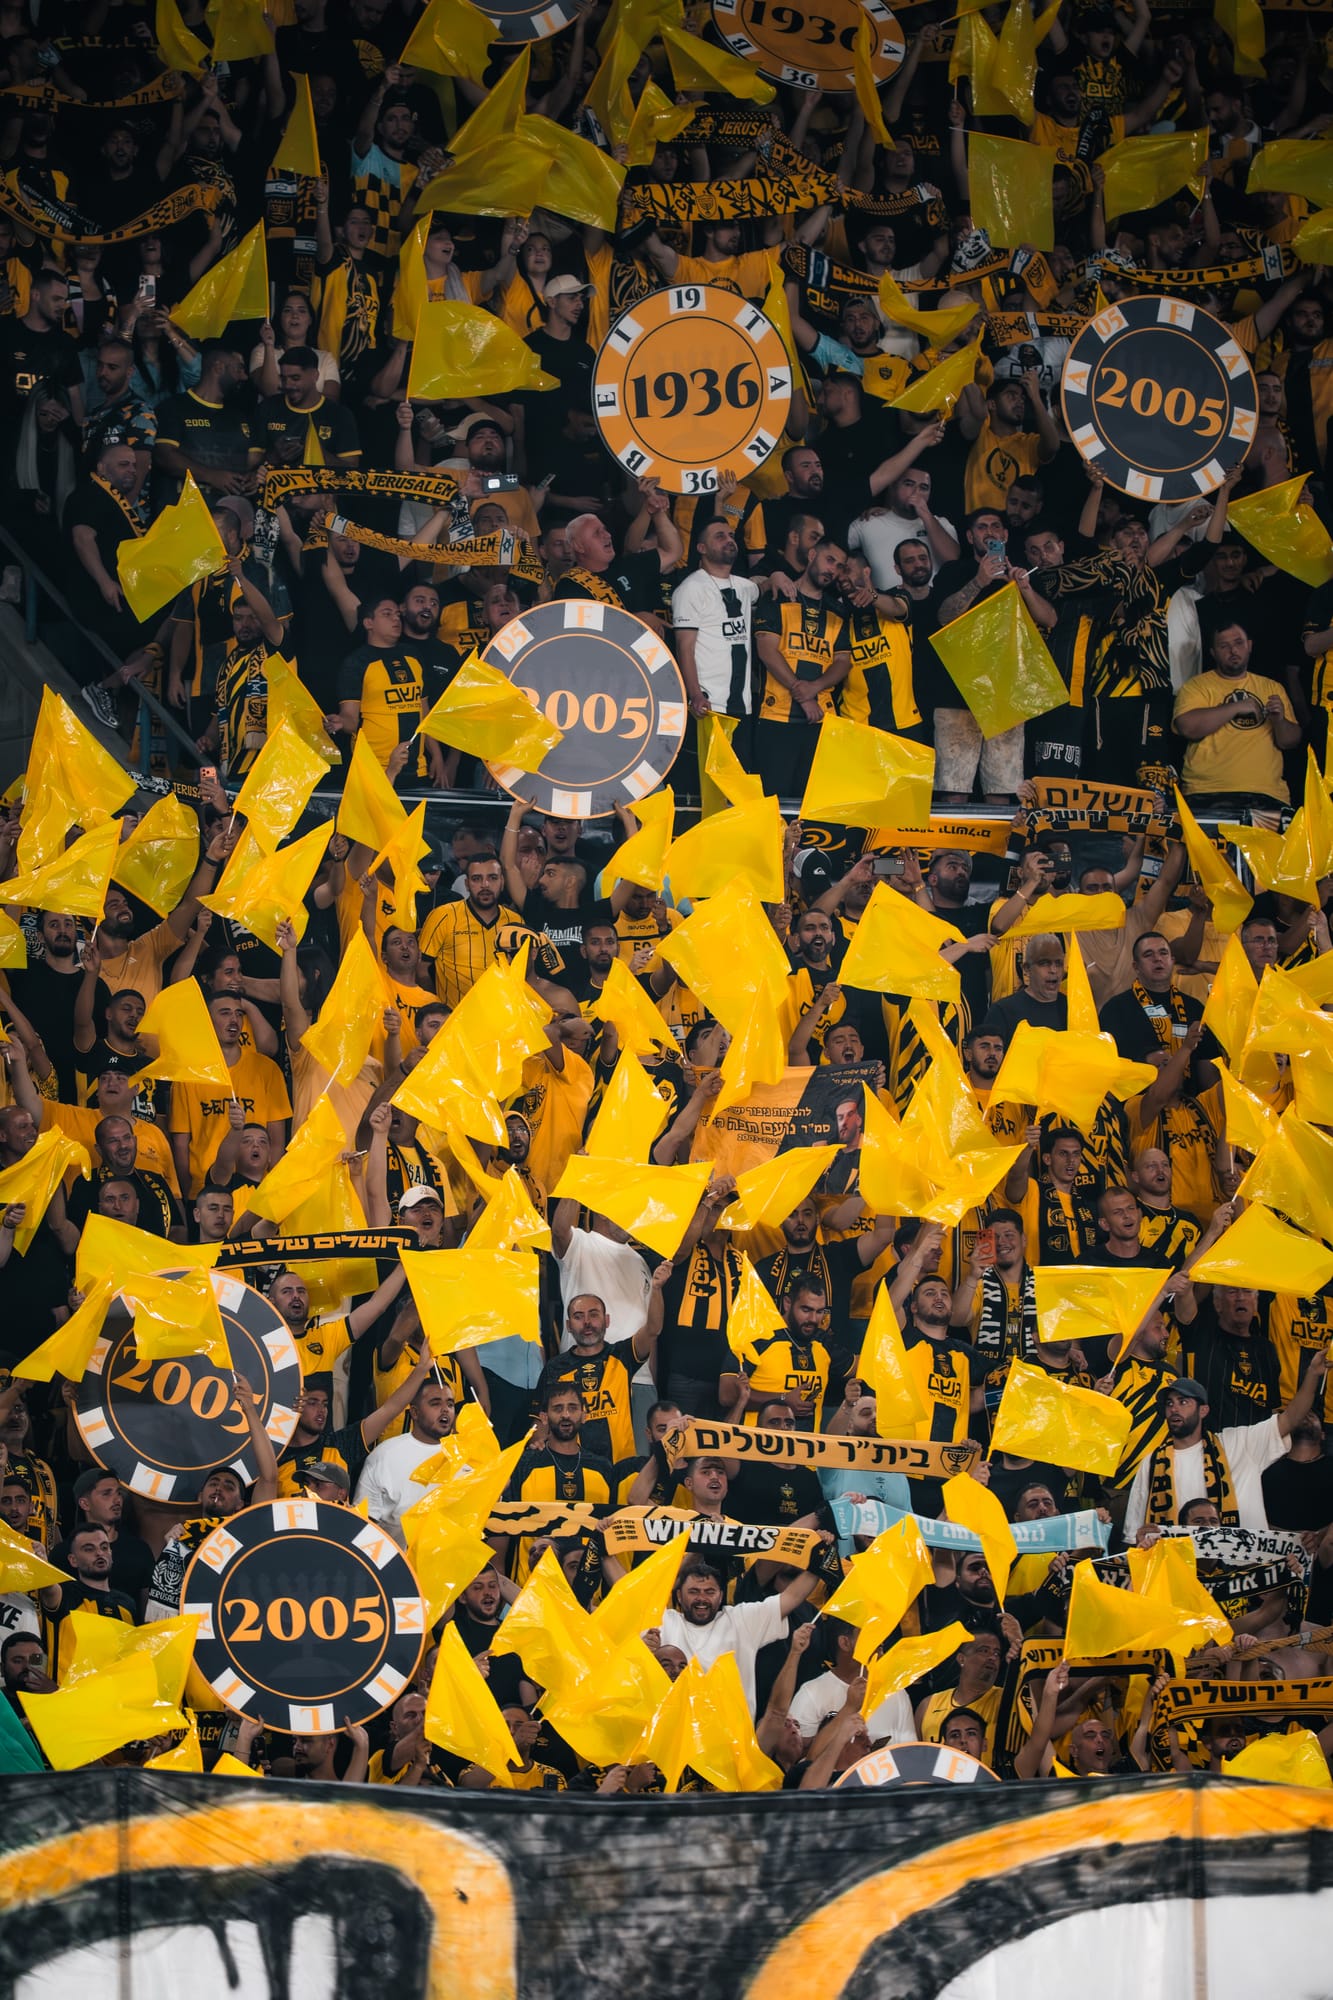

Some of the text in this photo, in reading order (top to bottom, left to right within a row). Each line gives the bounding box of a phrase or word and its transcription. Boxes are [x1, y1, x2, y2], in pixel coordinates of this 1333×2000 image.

[785, 67, 816, 88] 36
[718, 119, 771, 137] JERUSA
[675, 287, 701, 310] 19
[1099, 310, 1127, 338] 05
[629, 361, 760, 420] 1936
[1095, 367, 1227, 438] 2005
[368, 473, 454, 498] JERUSALEM
[685, 469, 717, 493] 36
[1074, 1175, 1096, 1187] CBJ
[266, 1238, 310, 1251] של
[313, 1233, 412, 1250] ירושלים
[927, 1373, 962, 1398] גשם
[696, 1427, 930, 1469] בית"ר ירושלים
[643, 1518, 779, 1551] WINNERS
[200, 1531, 237, 1569] 05
[148, 1588, 180, 1606] JERUSALE
[224, 1595, 386, 1645] 2005
[1170, 1682, 1283, 1707] ירושלים
[865, 1757, 898, 1781] 05
